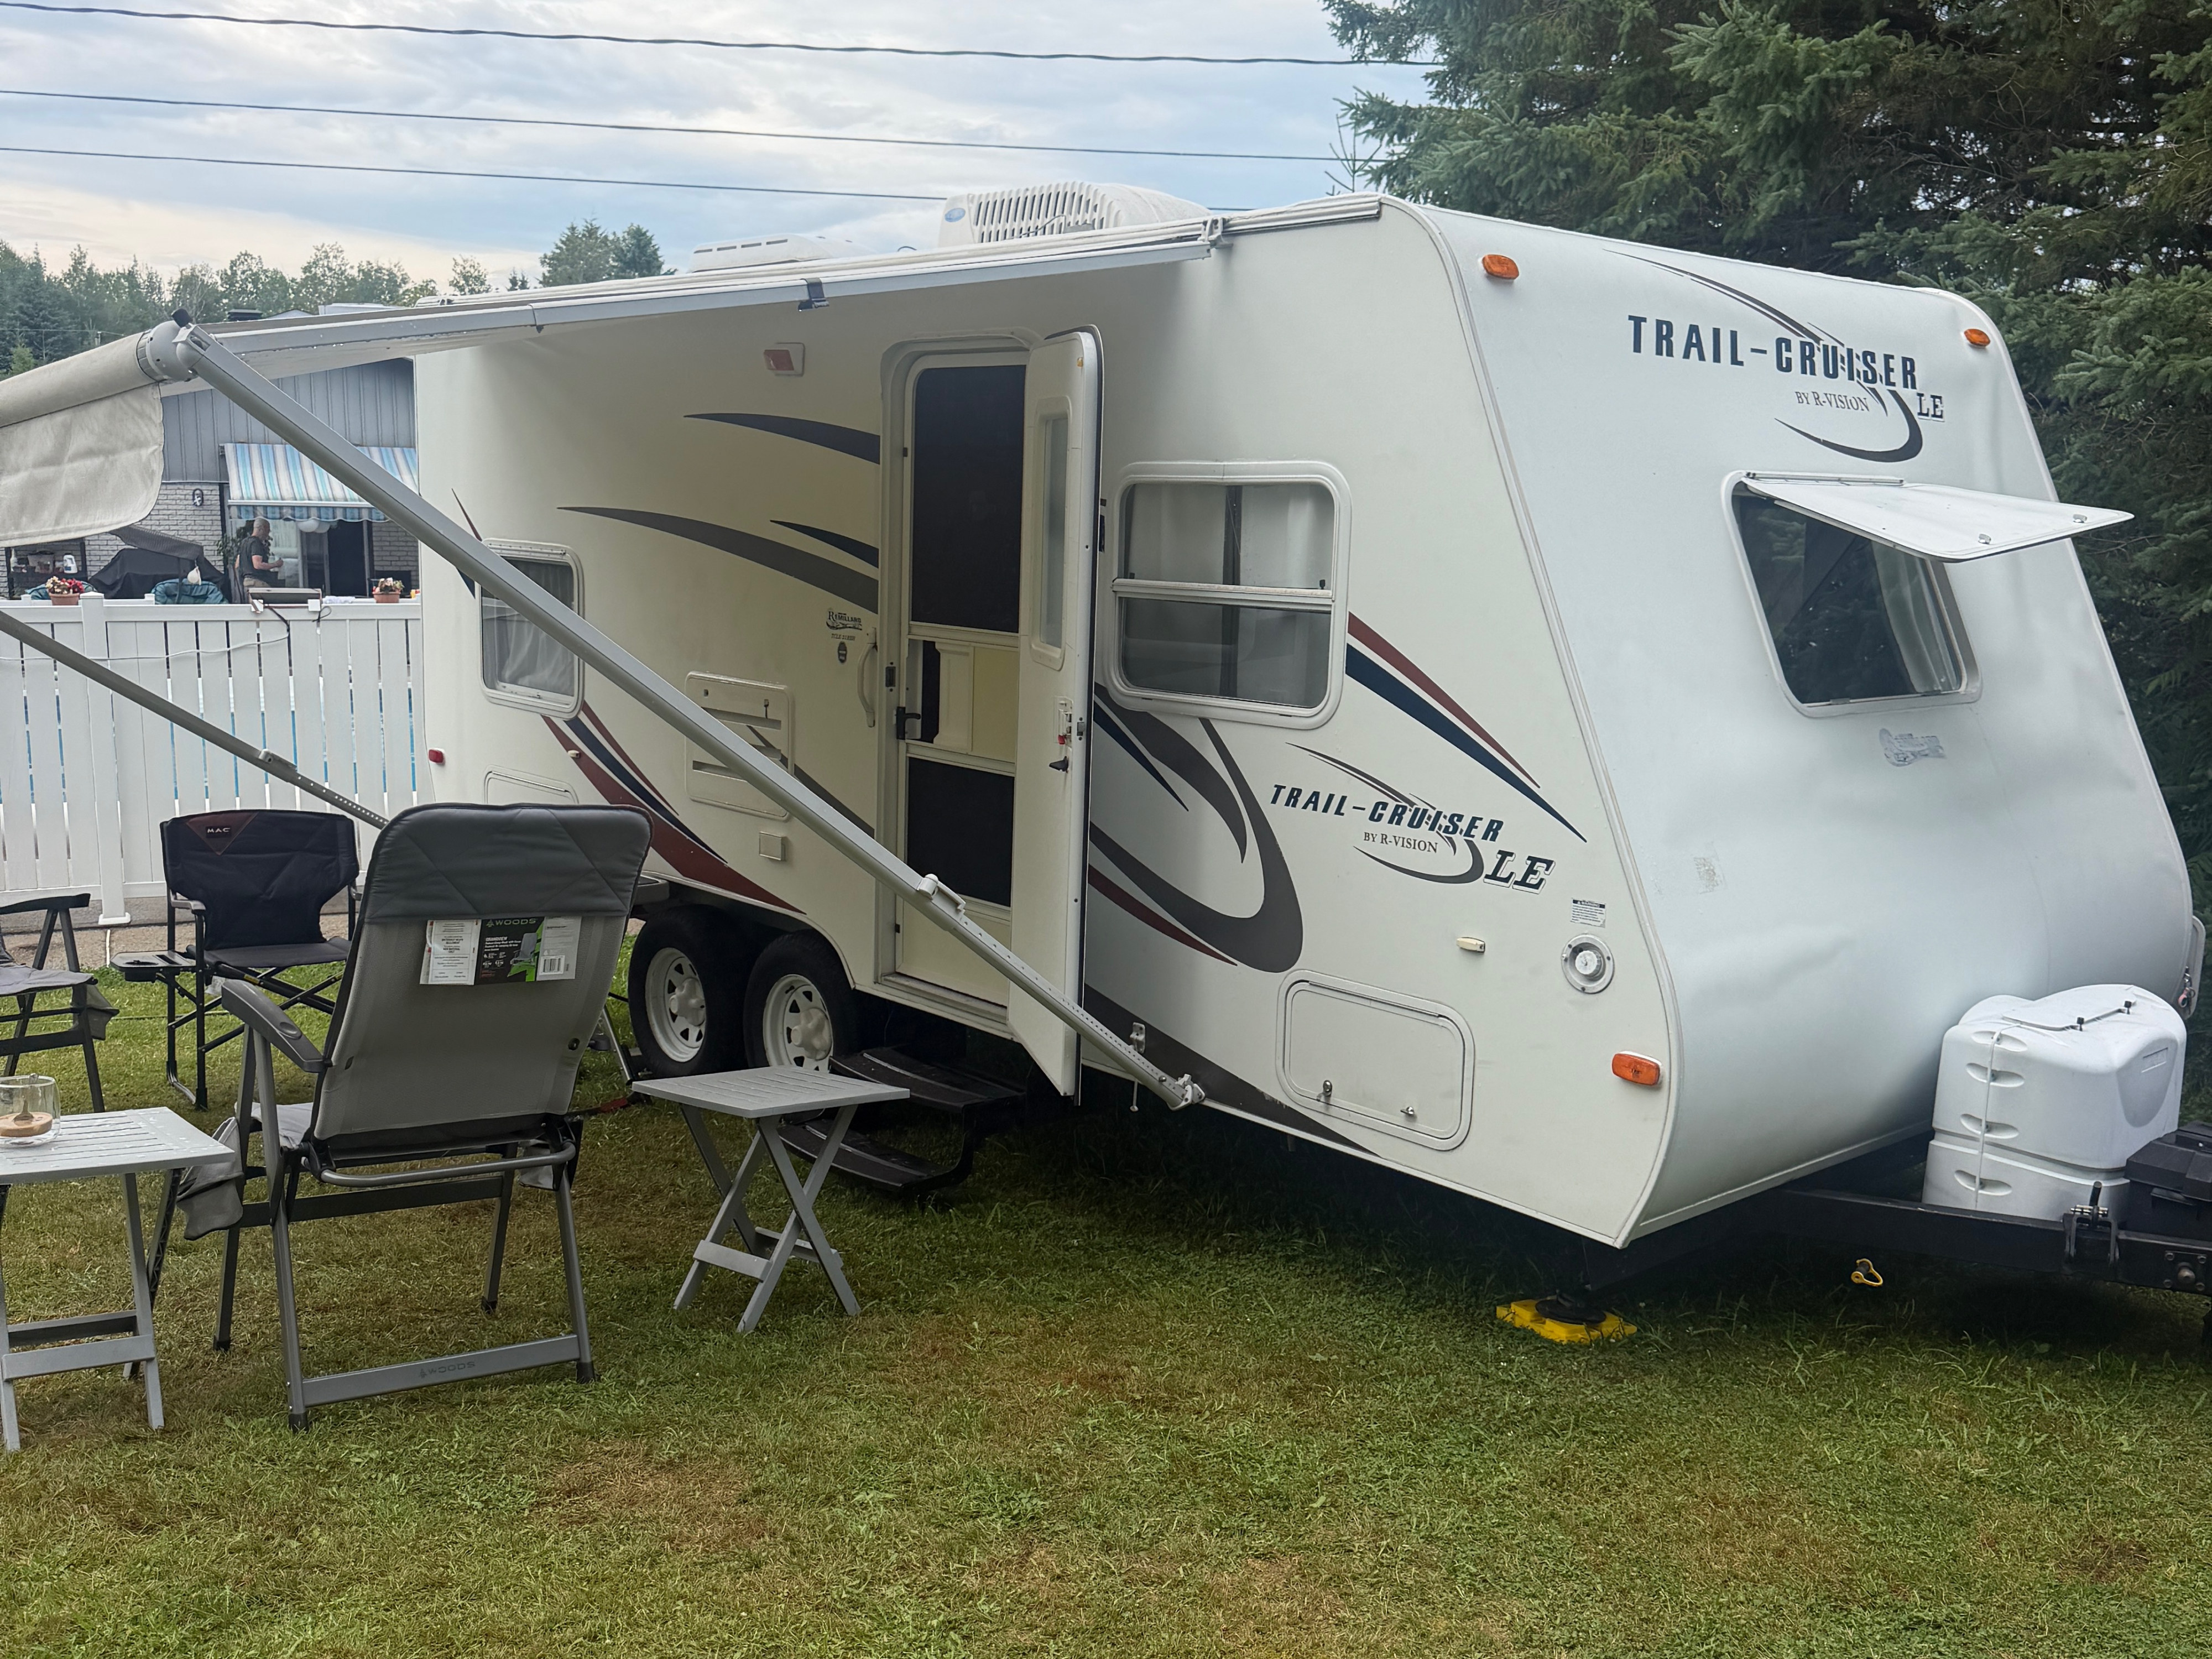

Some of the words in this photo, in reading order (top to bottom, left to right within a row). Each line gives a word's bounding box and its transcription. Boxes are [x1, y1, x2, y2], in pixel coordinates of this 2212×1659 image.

[1627, 315, 1918, 390] TRAIL-CRUISER
[1795, 390, 1812, 405] BY
[1812, 391, 1870, 413] R-VISION
[1916, 392, 1945, 422] LE
[1270, 784, 1504, 843] TRAIL-CRUISER
[1363, 831, 1378, 843] BY
[1379, 833, 1438, 854] R-VISION
[1483, 849, 1556, 895] LE
[428, 1361, 476, 1374] WOODS
